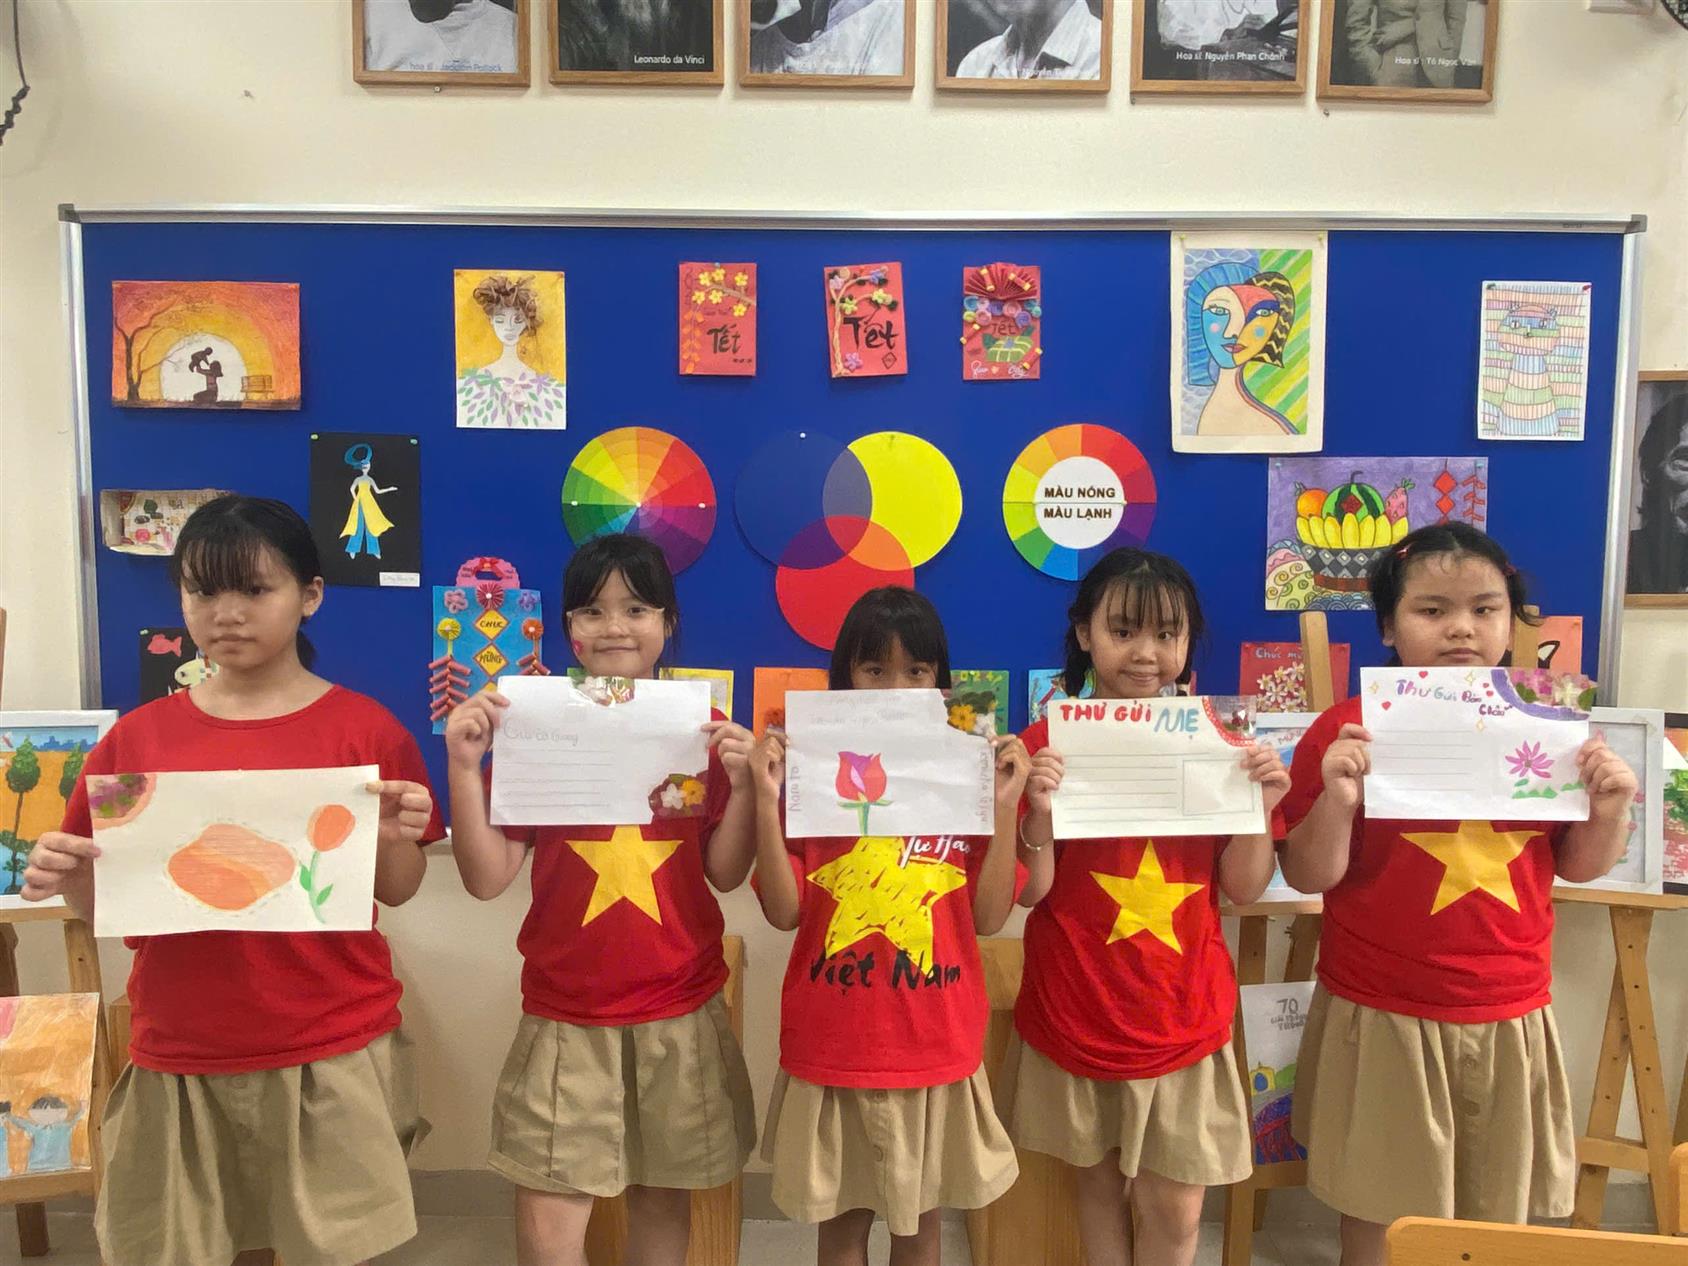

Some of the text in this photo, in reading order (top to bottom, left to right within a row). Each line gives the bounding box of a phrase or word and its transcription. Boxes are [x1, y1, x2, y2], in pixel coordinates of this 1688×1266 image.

[634, 54, 705, 64] Leonardo da Vinci
[1237, 51, 1257, 60] Phan
[707, 324, 742, 354] Tết
[1045, 486, 1115, 498] MÀU NÓNG
[1044, 506, 1111, 520] MÀU LẠNH
[1060, 702, 1107, 721] THƯ
[1154, 708, 1199, 739] MẸ
[811, 948, 961, 996] Việt Nam
